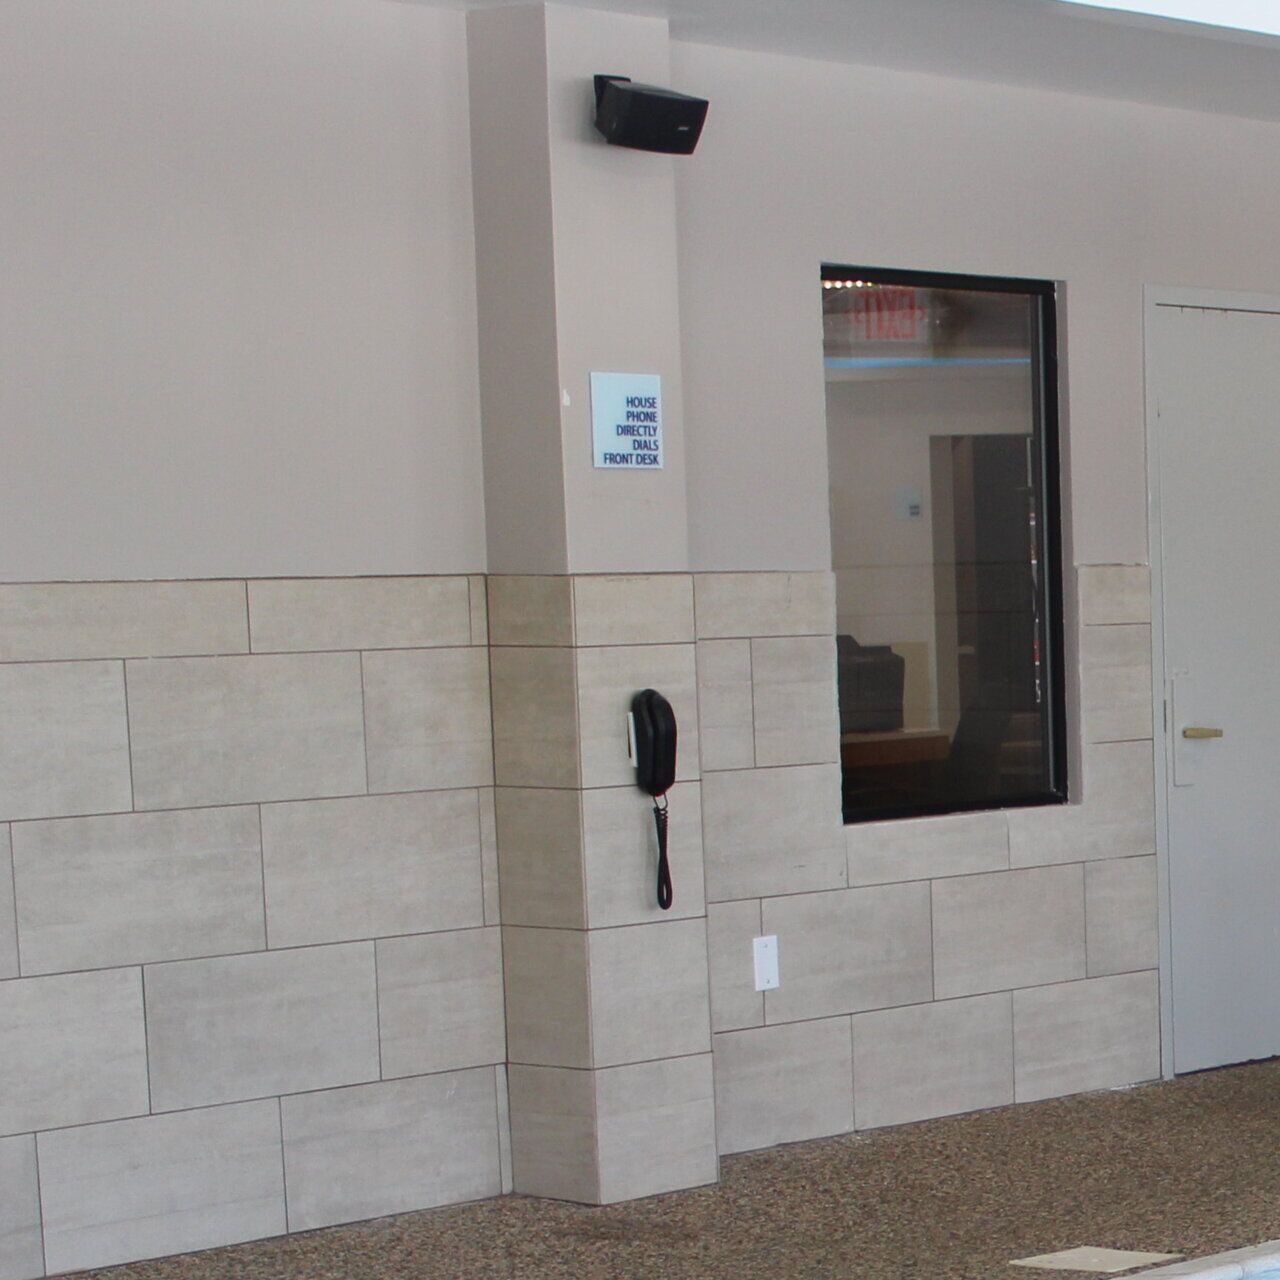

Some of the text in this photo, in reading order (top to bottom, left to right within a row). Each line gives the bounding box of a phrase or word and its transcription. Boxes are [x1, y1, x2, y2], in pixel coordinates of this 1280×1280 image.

[626, 396, 657, 409] HOUSE
[626, 410, 657, 423] PHONE
[616, 424, 658, 437] DIRECTLY
[632, 439, 659, 451] DIALS
[603, 452, 659, 465] FRONT DESK
